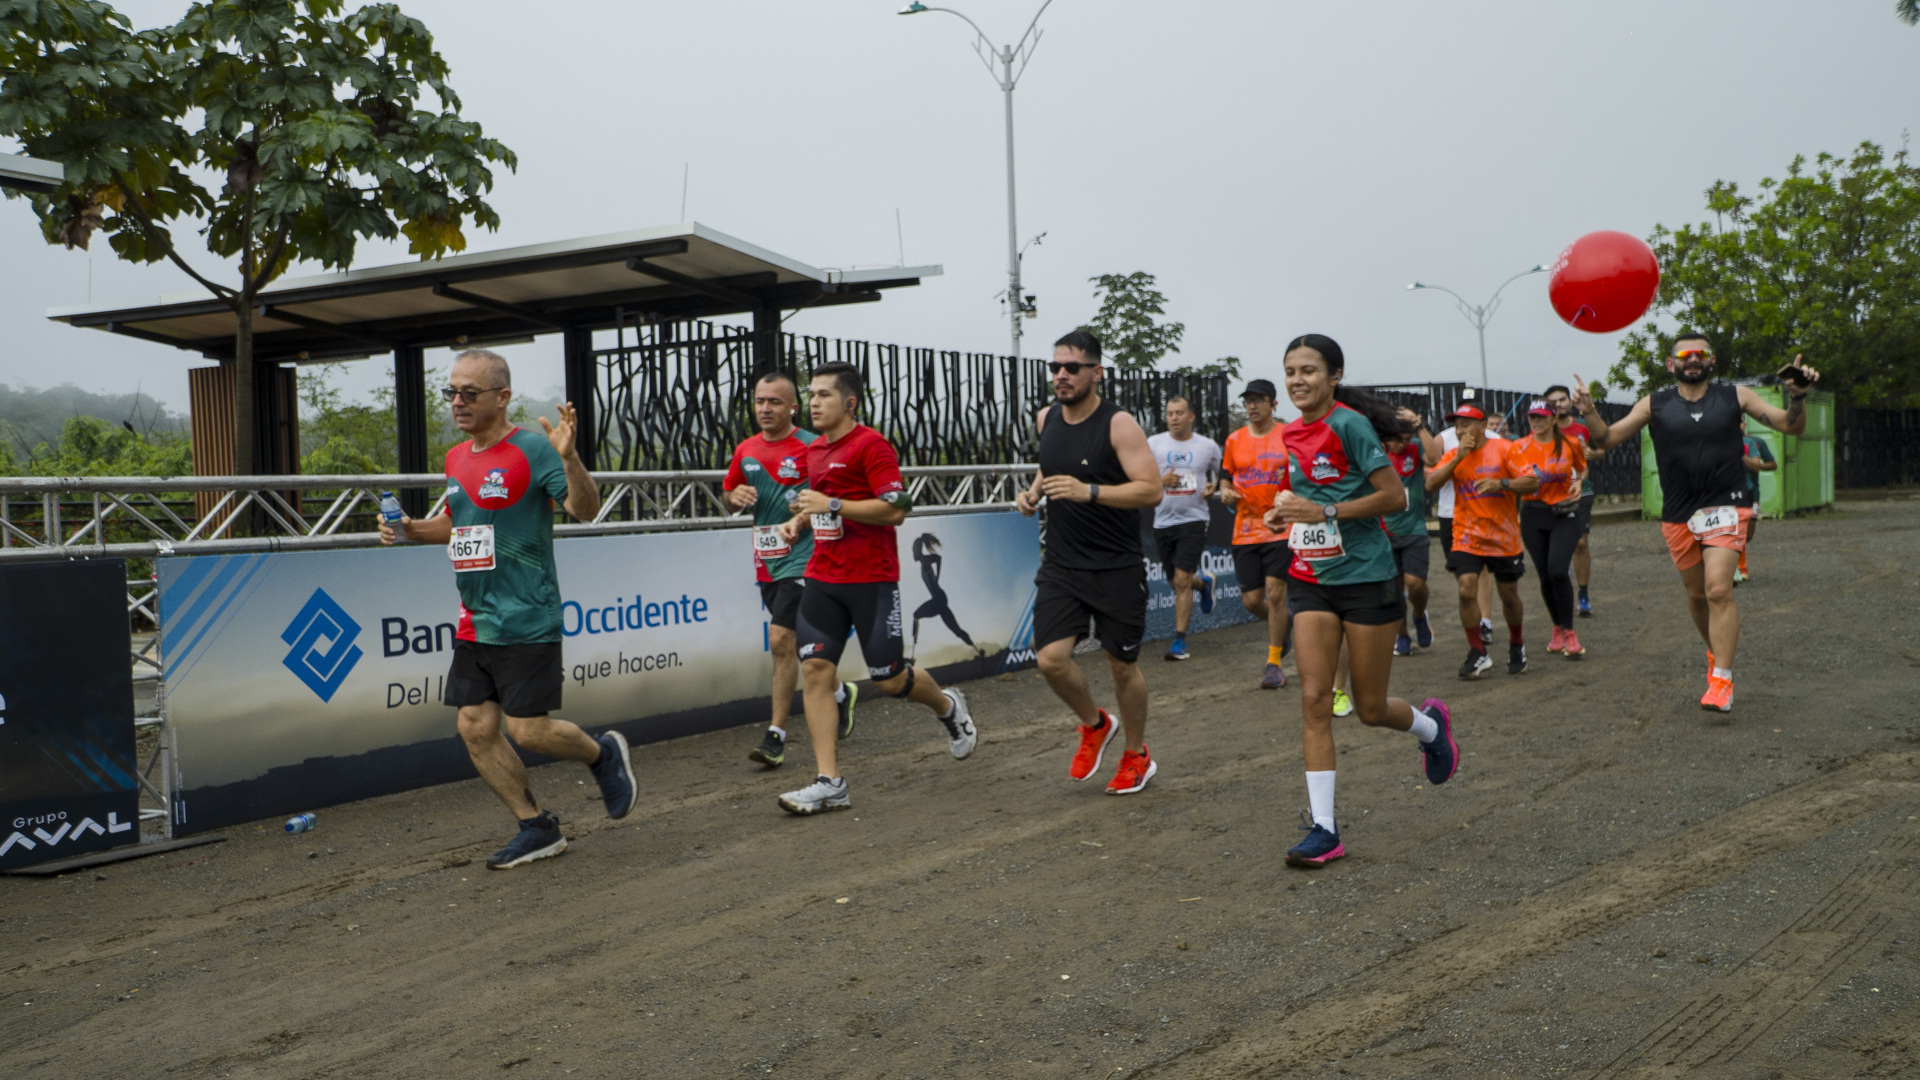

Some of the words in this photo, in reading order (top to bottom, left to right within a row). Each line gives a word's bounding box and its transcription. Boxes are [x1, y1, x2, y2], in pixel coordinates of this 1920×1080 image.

[1705, 516, 1720, 528] 44
[1303, 530, 1326, 545] 846
[451, 539, 482, 558] 1667
[382, 617, 455, 658] Ban
[562, 593, 708, 637] Occidente
[1005, 648, 1037, 666] AVA
[387, 676, 429, 709] Del
[573, 655, 612, 687] que
[618, 650, 683, 675] hacen.
[13, 811, 68, 828] Grupo
[0, 812, 132, 857] AVAL
